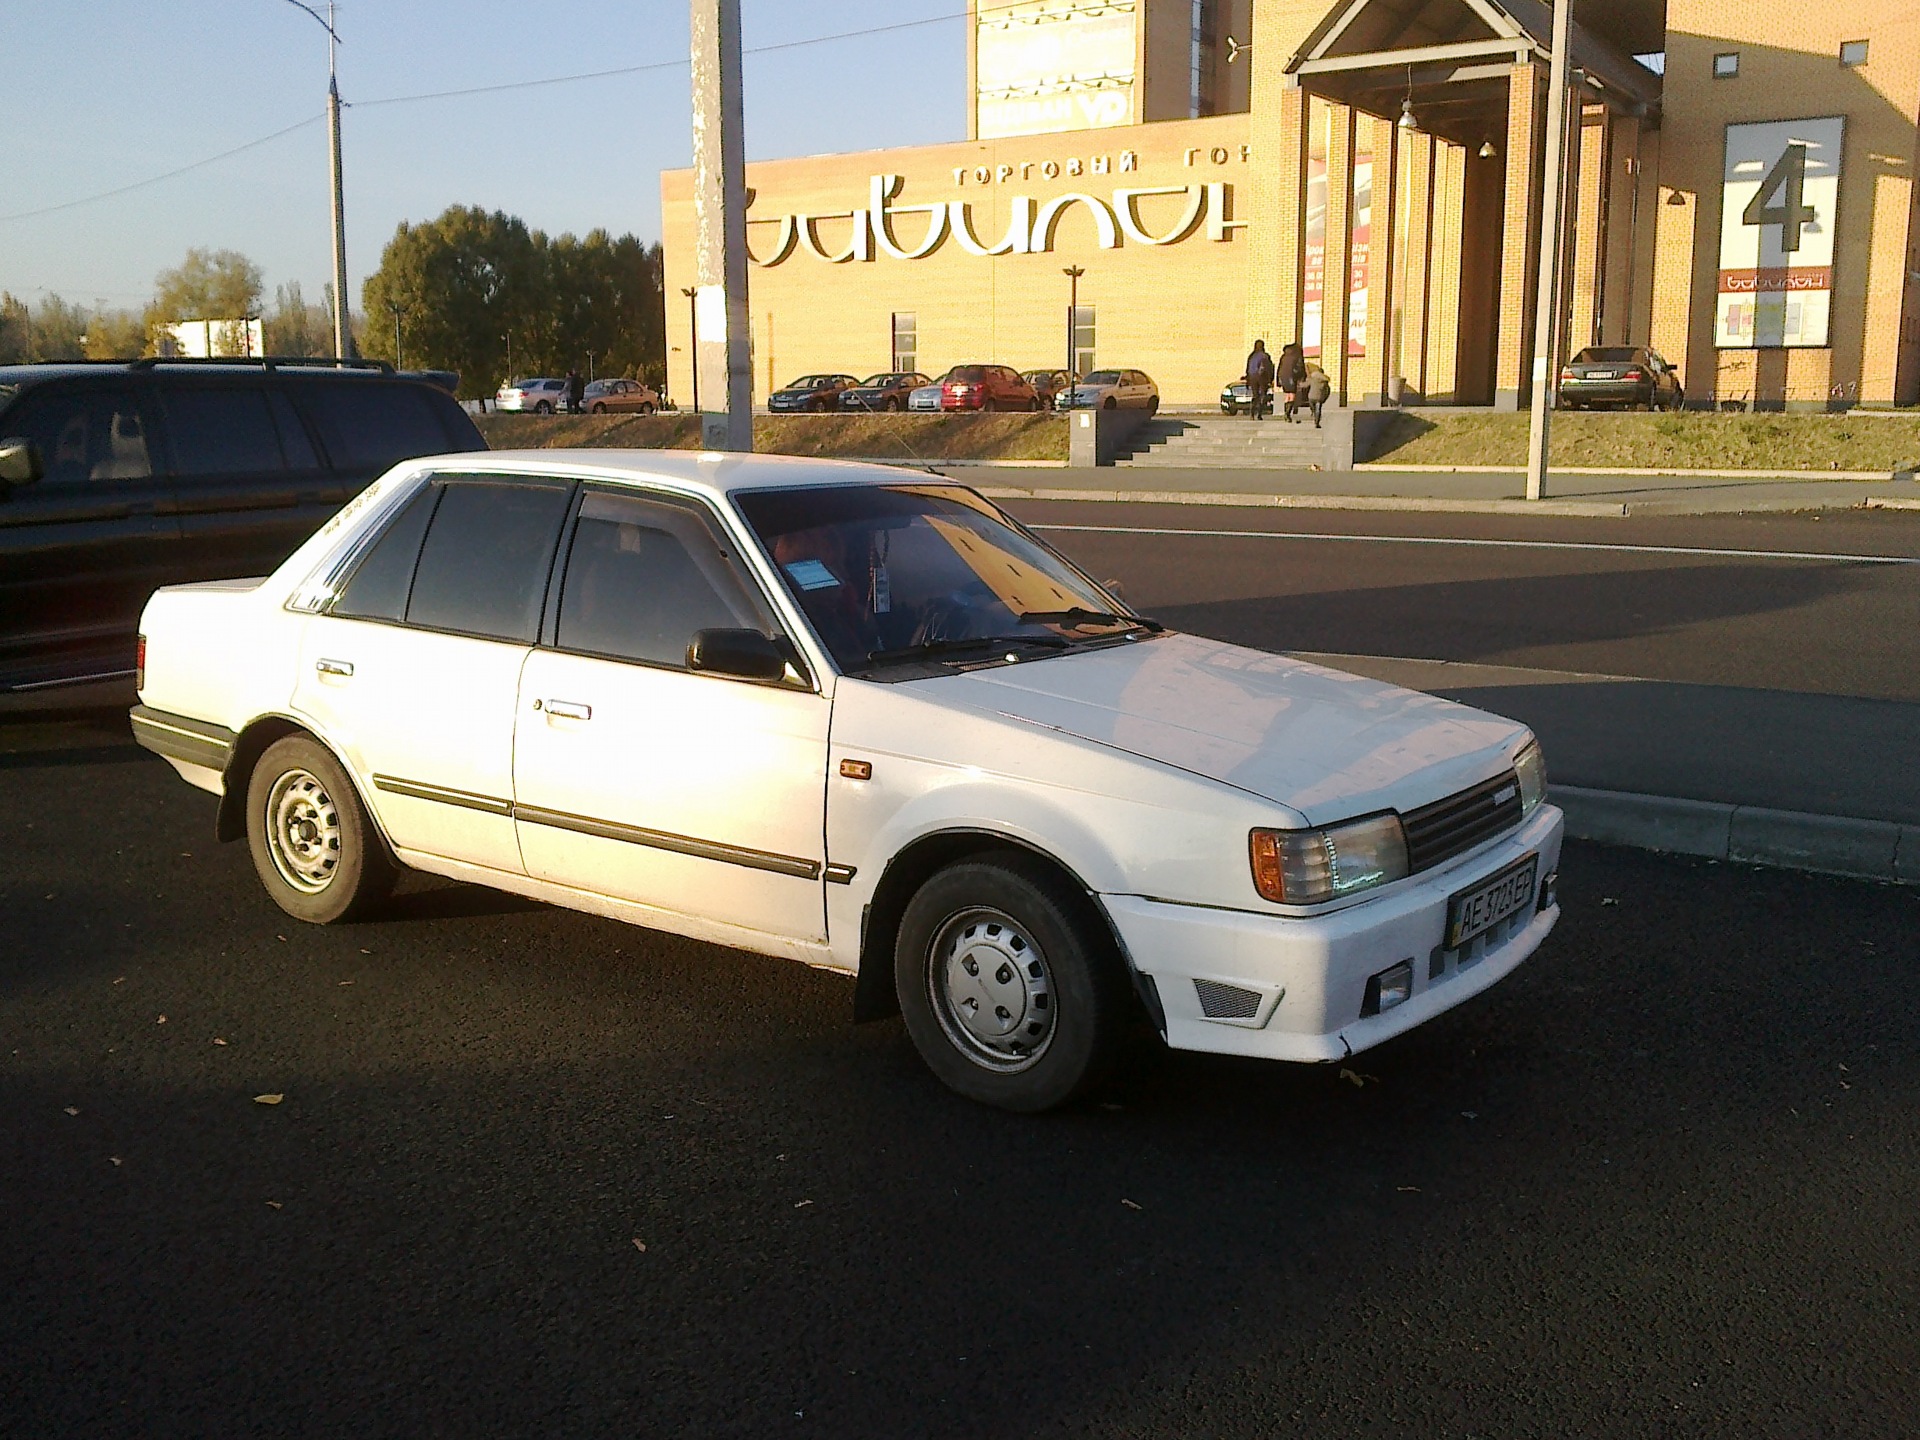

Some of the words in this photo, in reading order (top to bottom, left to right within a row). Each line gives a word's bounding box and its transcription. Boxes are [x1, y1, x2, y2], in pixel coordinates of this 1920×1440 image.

[952, 150, 1138, 186] ТОРГОВЫЙ
[1742, 144, 1814, 252] 4
[1460, 894, 1484, 937] AE
